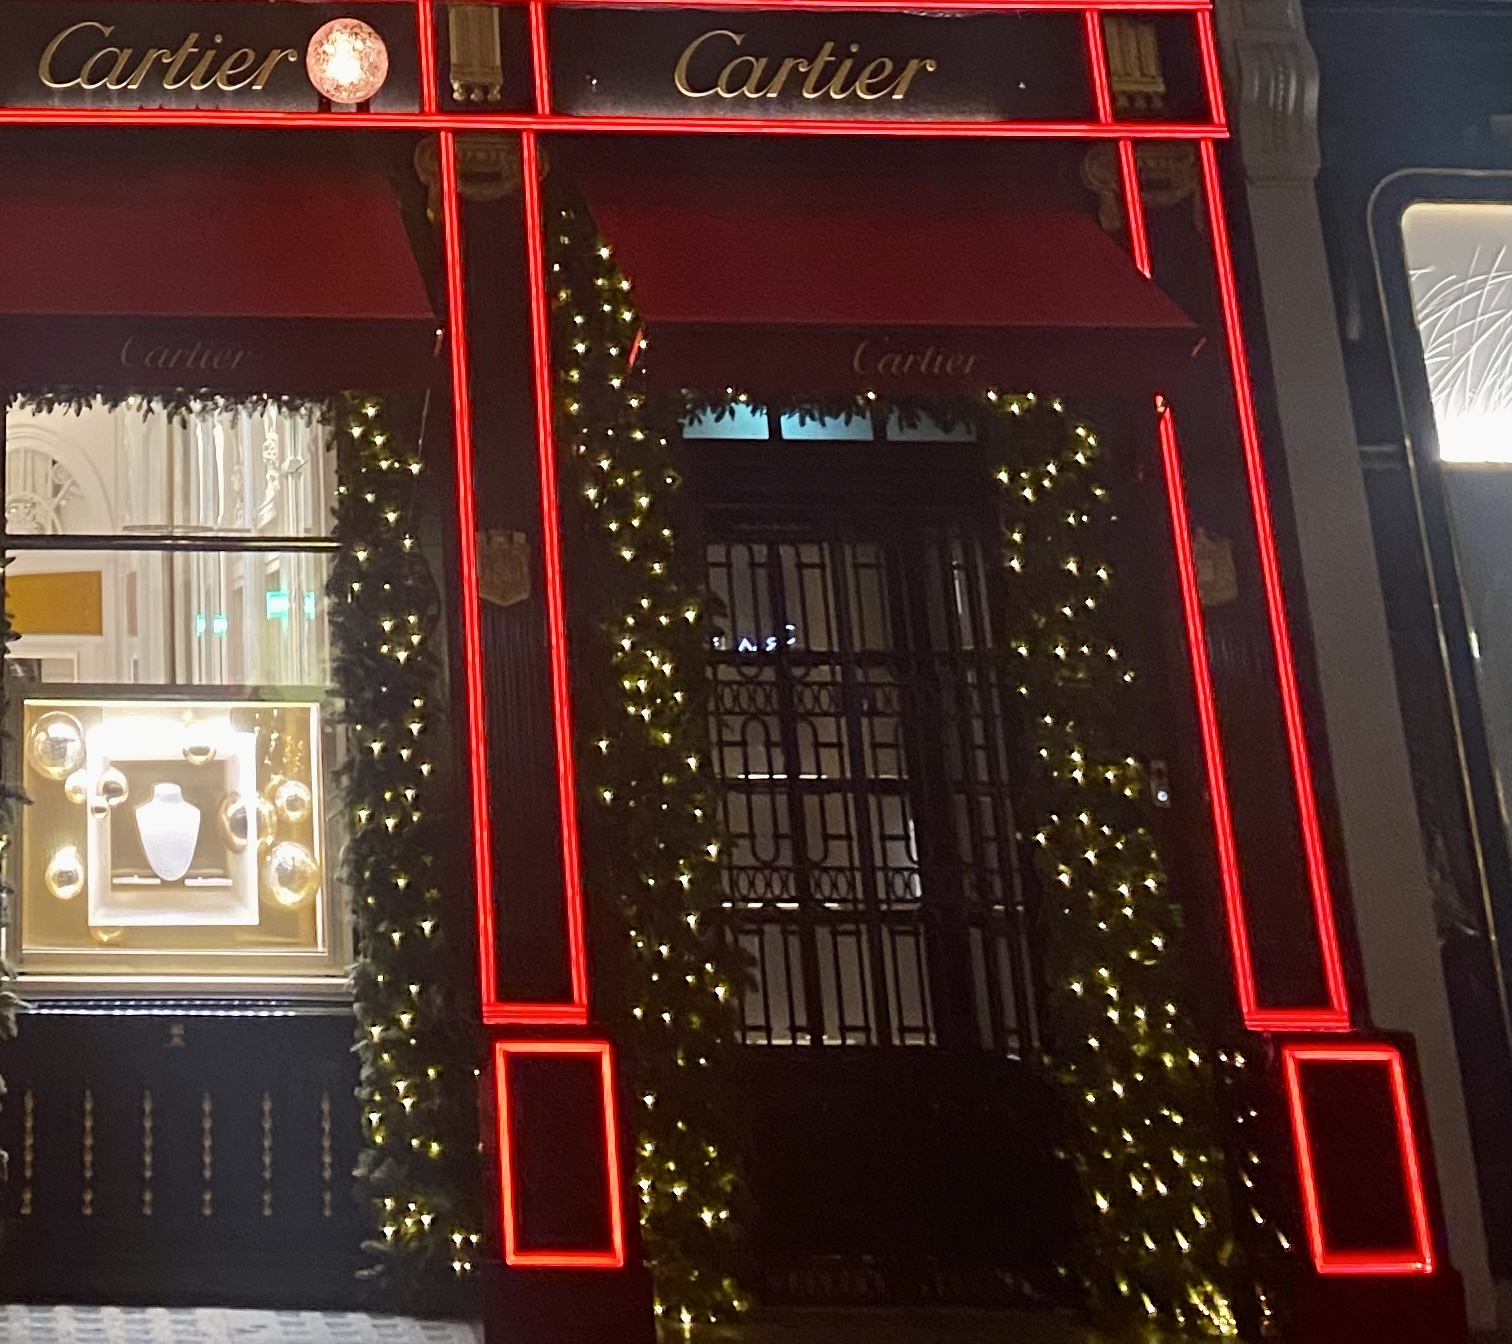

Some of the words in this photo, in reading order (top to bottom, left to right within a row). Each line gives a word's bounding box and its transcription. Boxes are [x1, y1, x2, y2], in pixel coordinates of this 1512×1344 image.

[37, 21, 298, 92] Cartier
[672, 29, 938, 101] Cartier
[120, 335, 255, 370] Cartier
[852, 337, 986, 376] Cartier
